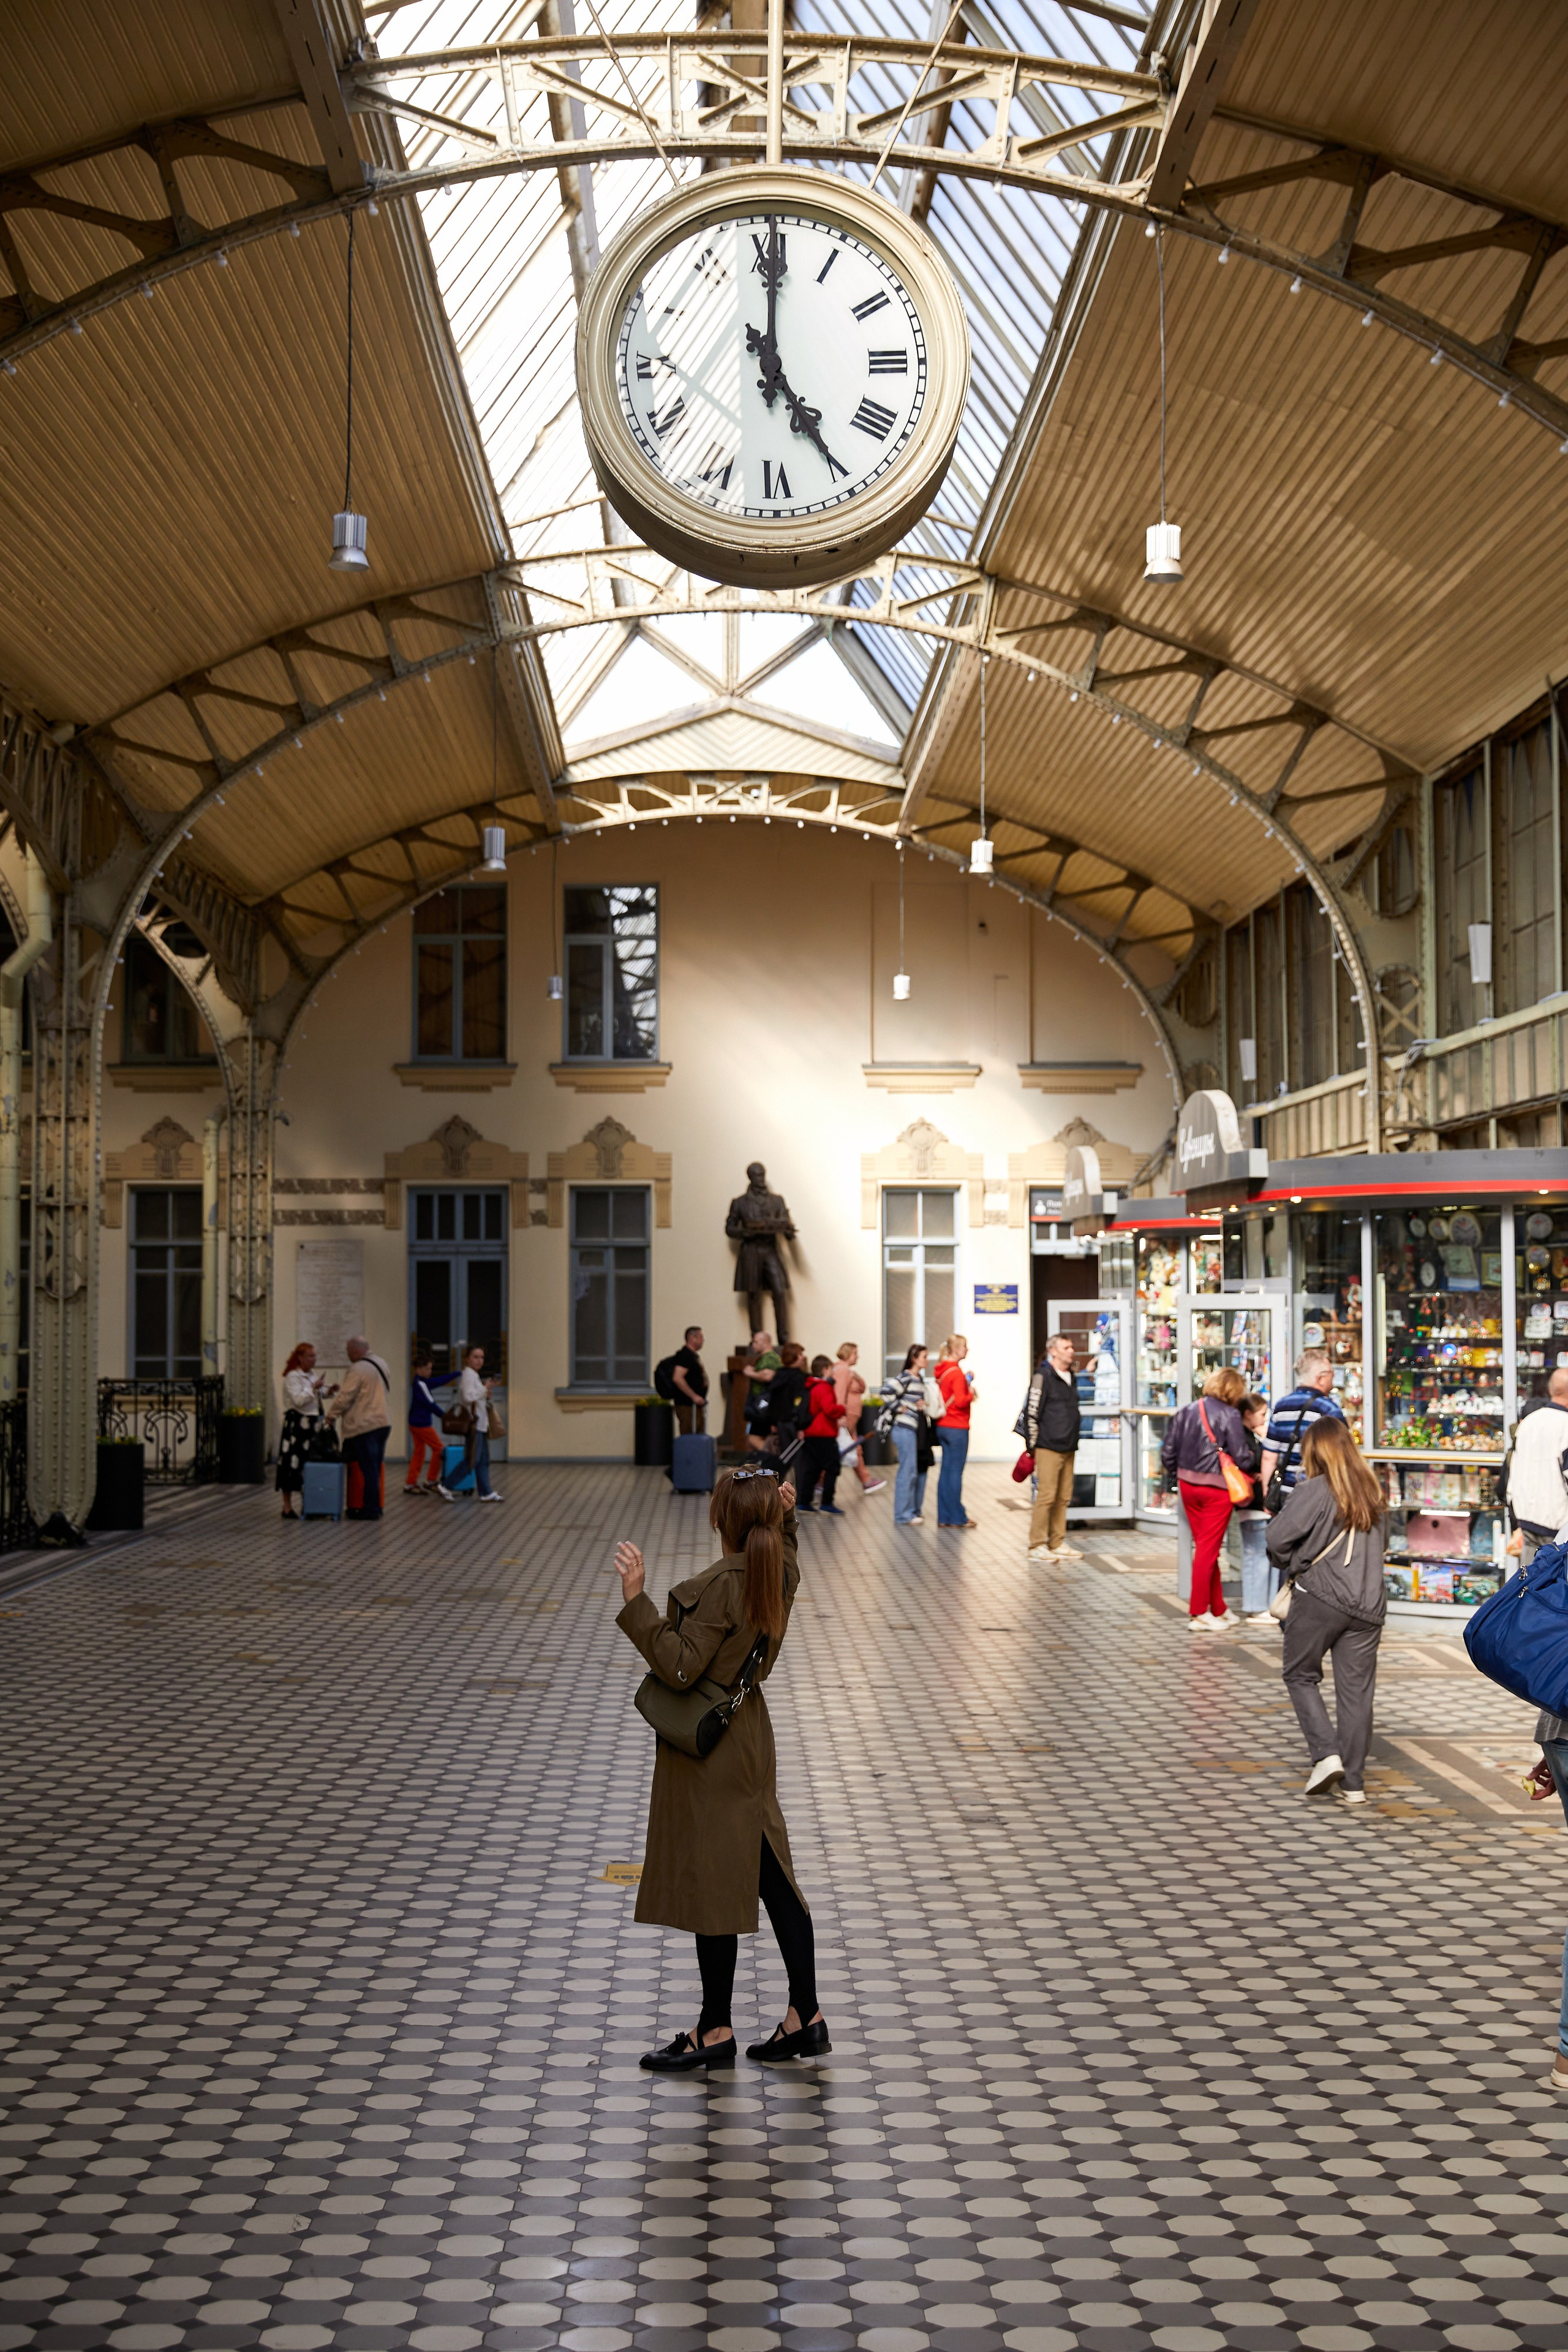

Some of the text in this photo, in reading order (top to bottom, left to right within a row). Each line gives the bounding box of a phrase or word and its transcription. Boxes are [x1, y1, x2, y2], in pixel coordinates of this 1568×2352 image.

[748, 232, 789, 274] XI
[813, 246, 843, 286] I
[848, 287, 892, 325] II
[867, 347, 908, 377] III
[848, 393, 899, 444] IIII
[761, 459, 794, 499] VI
